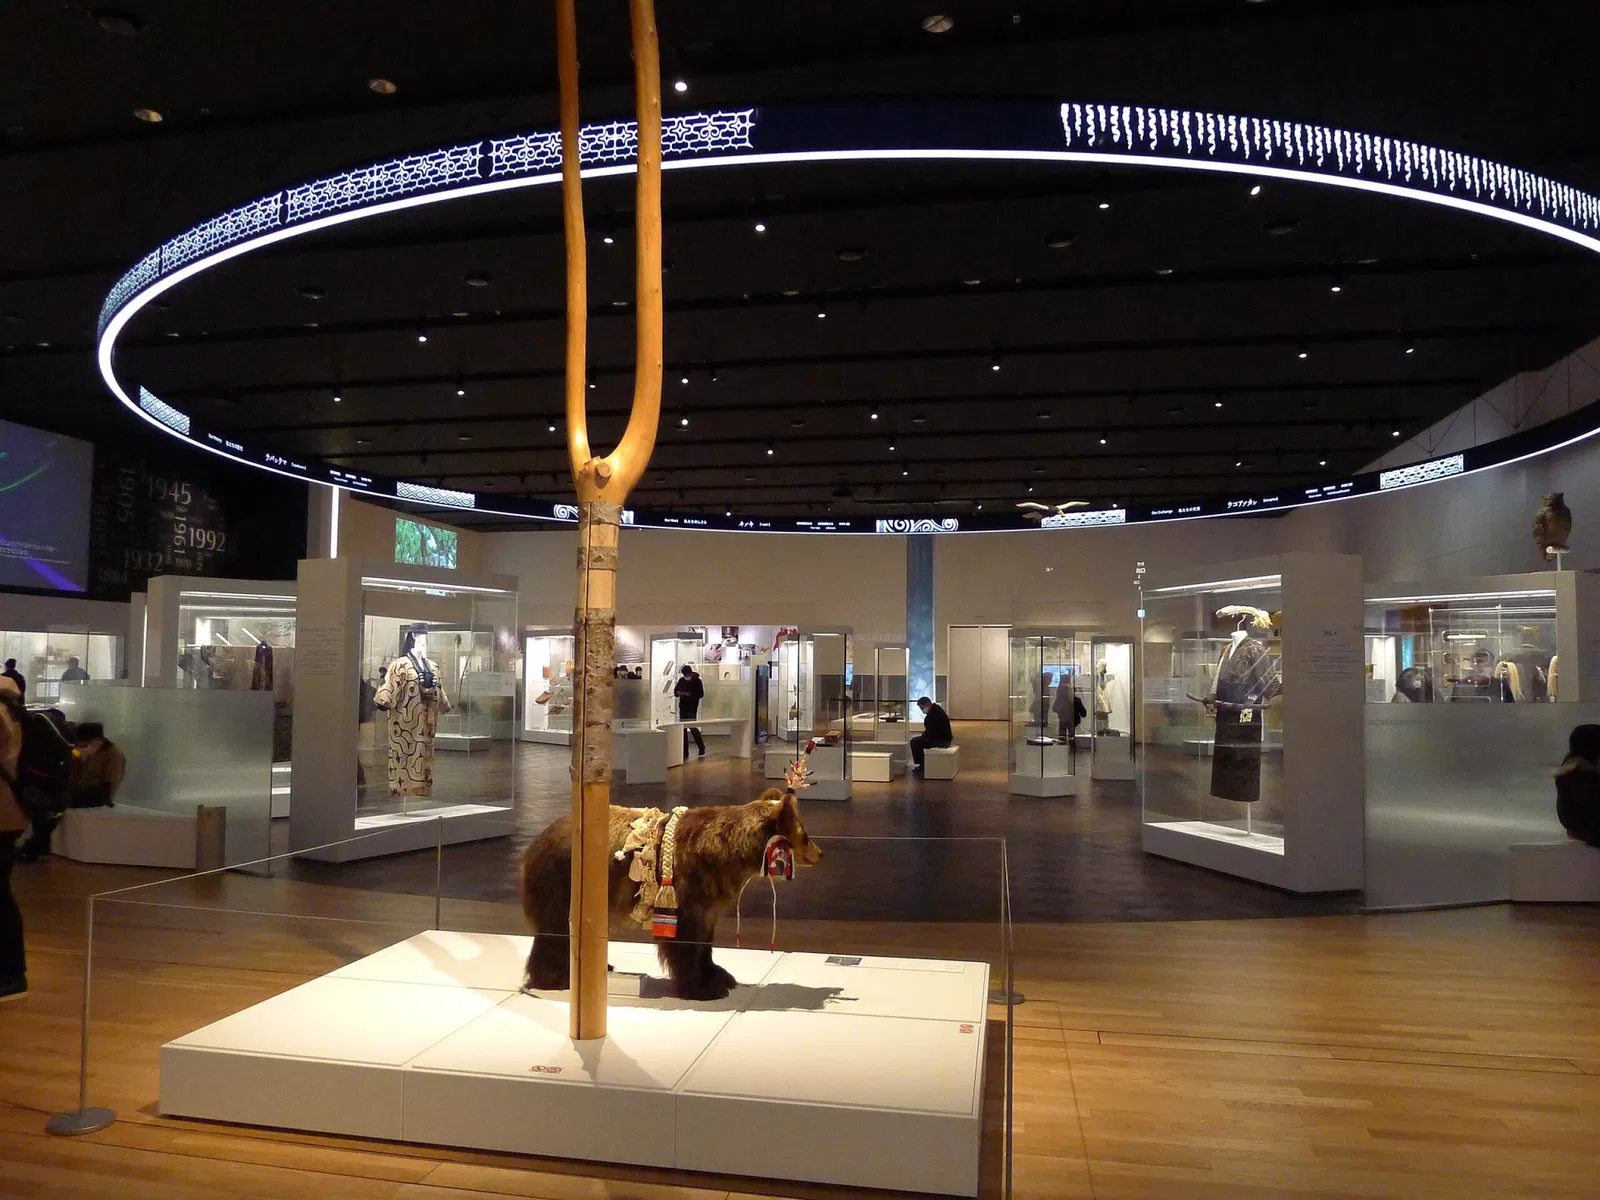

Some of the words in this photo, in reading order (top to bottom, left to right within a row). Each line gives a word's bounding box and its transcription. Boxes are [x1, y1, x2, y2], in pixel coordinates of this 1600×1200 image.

[116, 467, 136, 523] 1905
[148, 475, 192, 505] 1945
[173, 516, 187, 554] 1961
[189, 527, 226, 552] 1992
[124, 548, 163, 572] 1932
